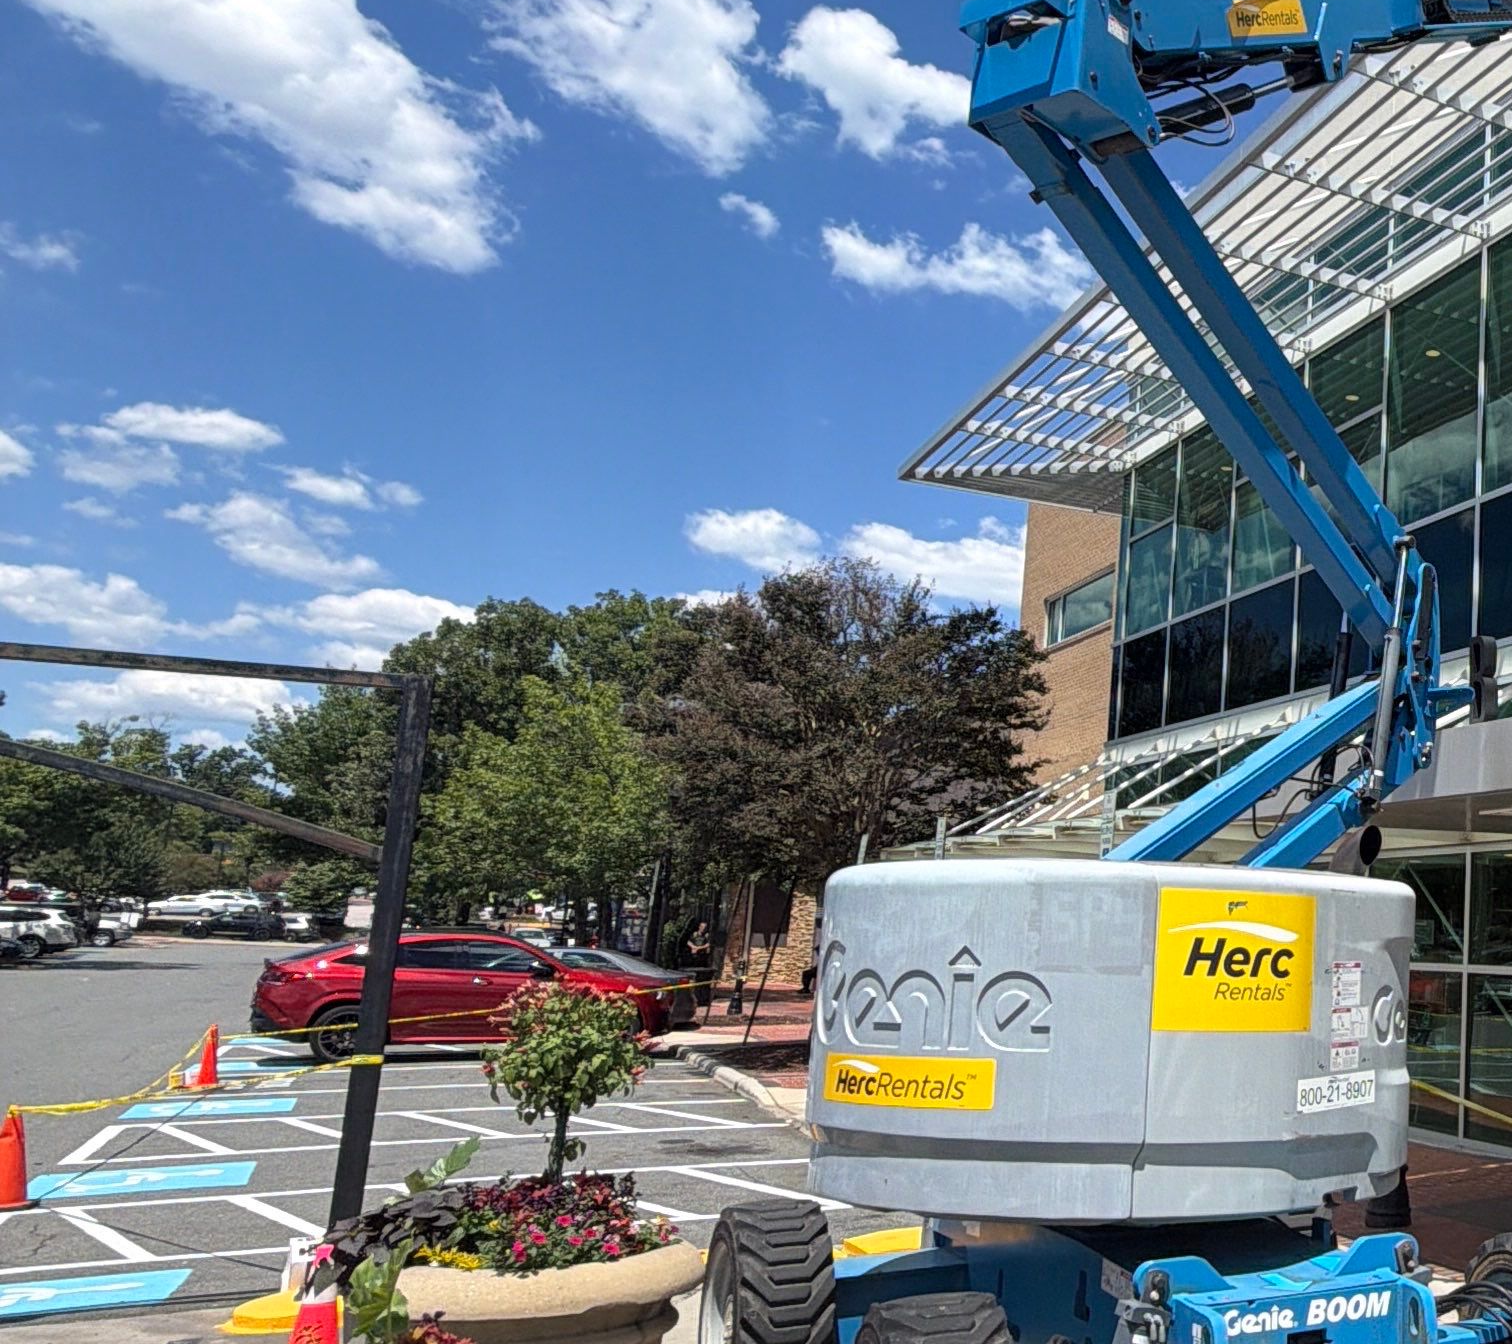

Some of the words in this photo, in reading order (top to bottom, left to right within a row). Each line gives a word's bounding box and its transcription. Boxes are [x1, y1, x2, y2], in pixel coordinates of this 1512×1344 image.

[1183, 937, 1295, 979] Herc
[816, 939, 1054, 1053] Genie
[1300, 1080, 1374, 1107] 800-21-8907
[1223, 1304, 1296, 1337] Genie
[1306, 1291, 1392, 1326] BOOM
